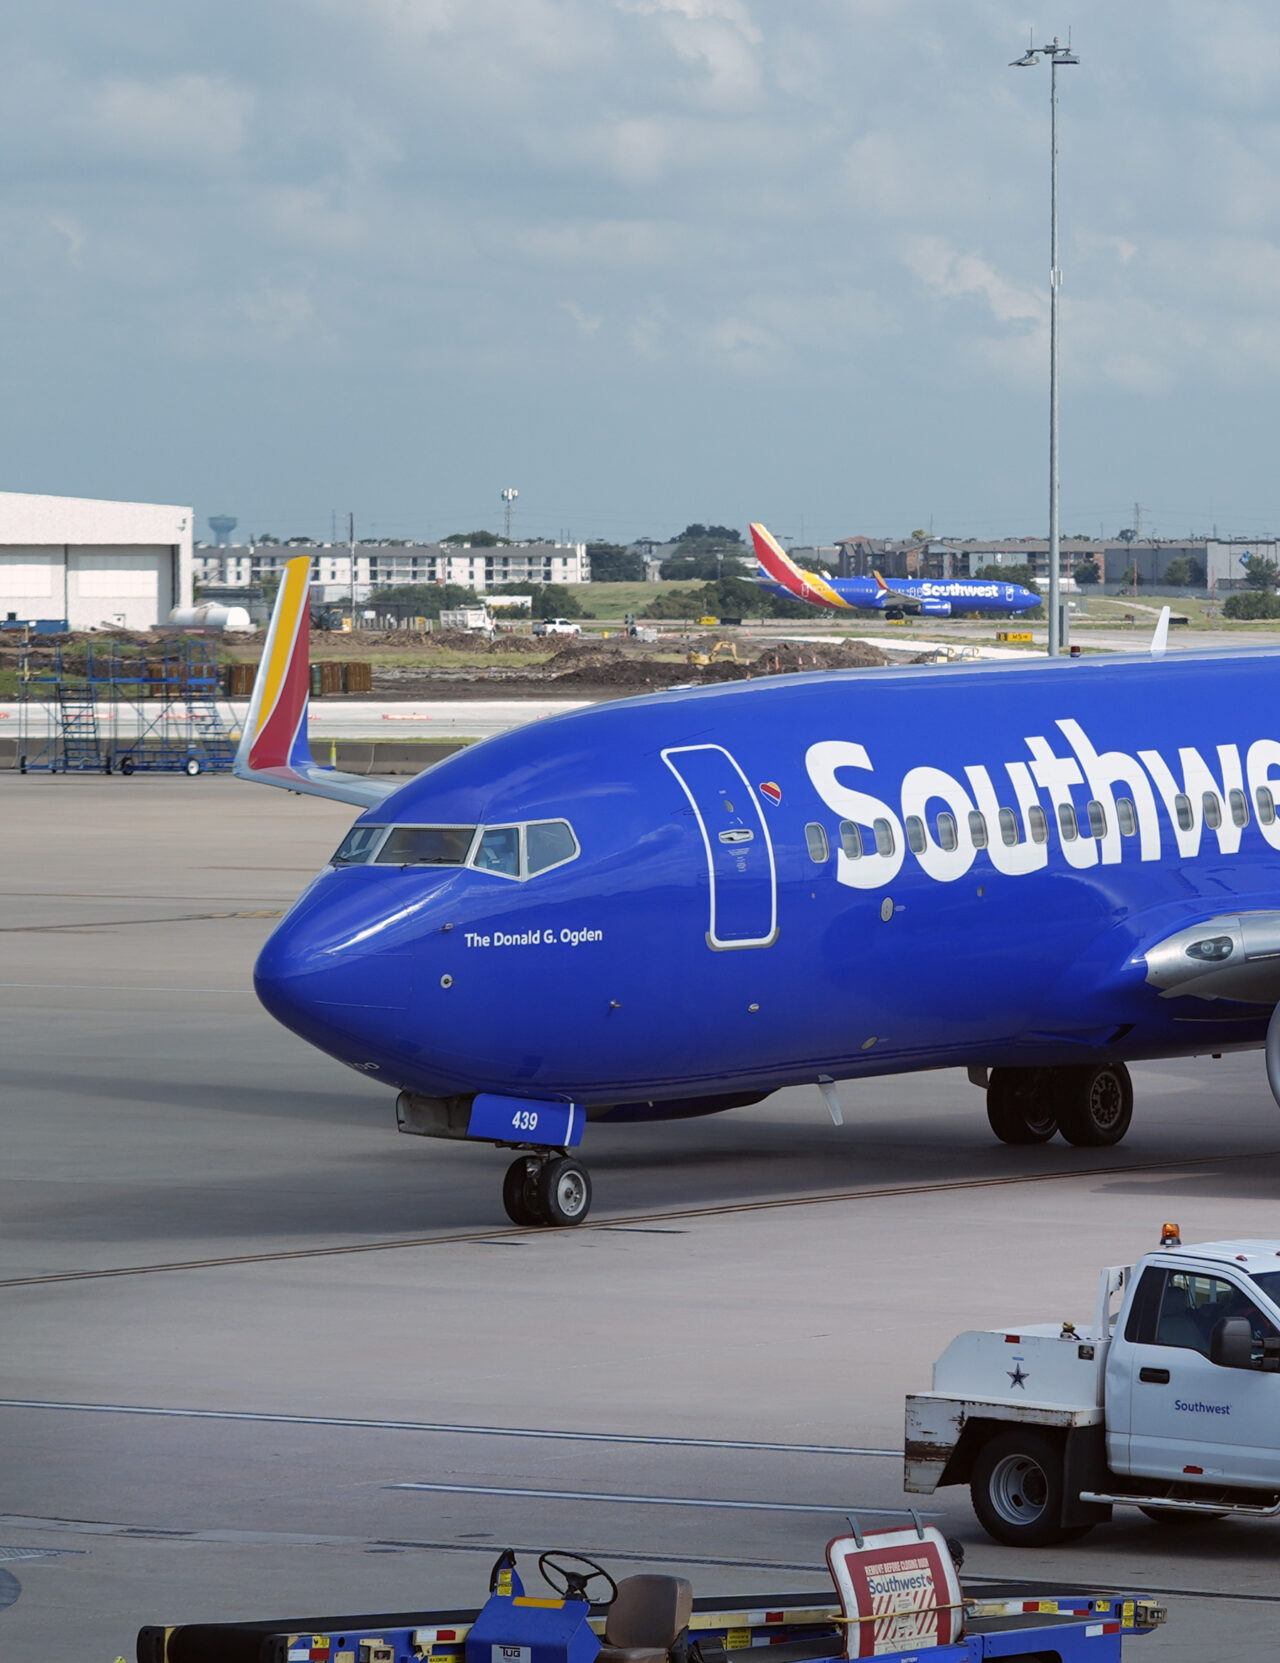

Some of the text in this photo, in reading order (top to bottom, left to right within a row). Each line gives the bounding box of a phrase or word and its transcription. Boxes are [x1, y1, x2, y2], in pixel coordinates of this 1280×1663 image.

[922, 583, 999, 598] Southwest
[464, 926, 603, 948] The Donald G. Ogden
[511, 1110, 538, 1131] 439
[1174, 1399, 1231, 1416] Southwest
[868, 1574, 927, 1595] Southwest
[499, 1646, 521, 1657] TUG
